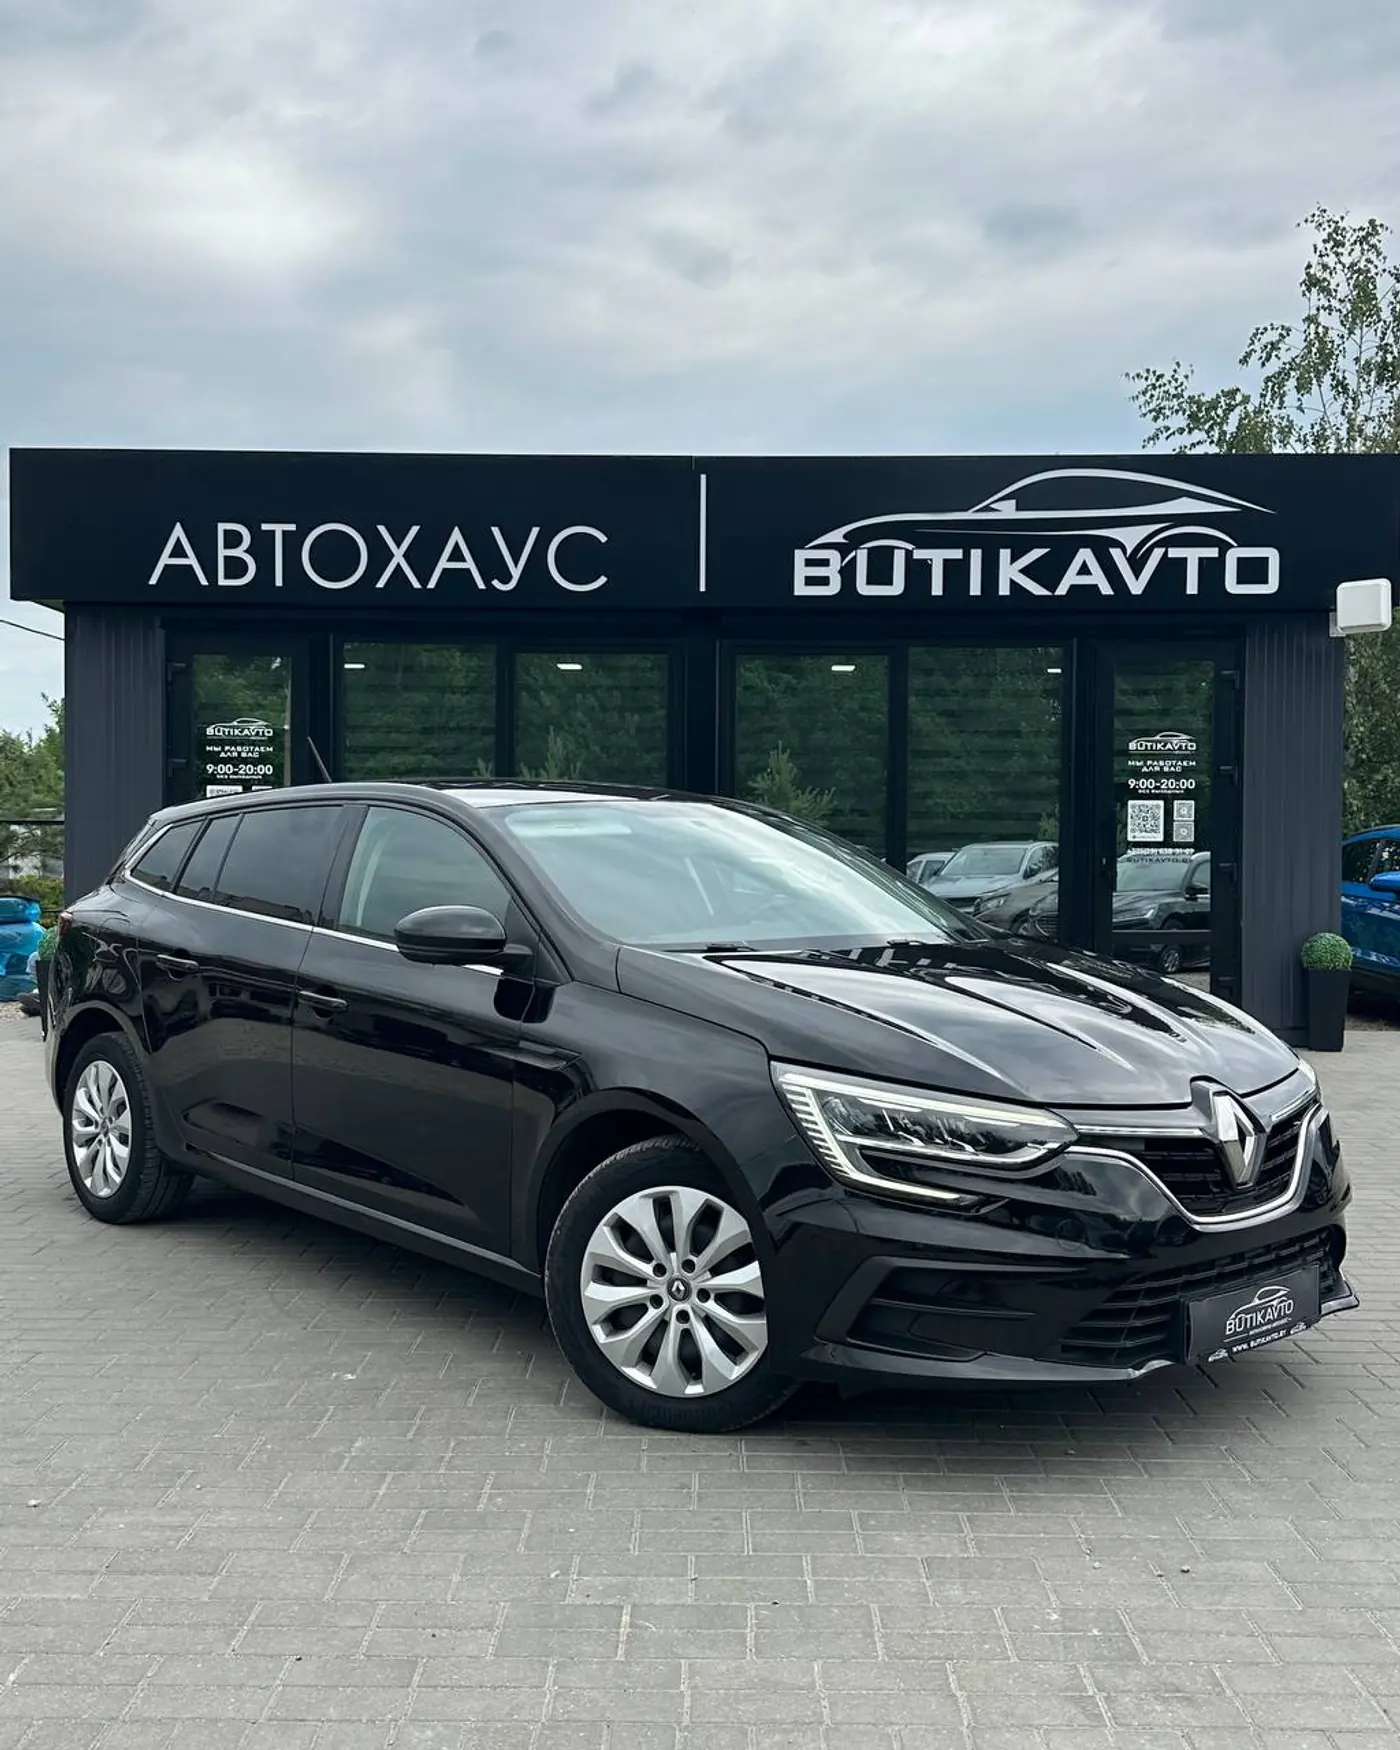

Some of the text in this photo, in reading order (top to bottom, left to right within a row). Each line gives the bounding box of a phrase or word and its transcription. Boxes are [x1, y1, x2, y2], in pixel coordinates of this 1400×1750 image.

[148, 521, 609, 593] АВТОХАУС
[793, 546, 1280, 597] BUTIKAVTO
[206, 727, 273, 737] BUTIKAVTO
[1128, 742, 1197, 751] BUTIKAVTO
[206, 764, 274, 775] 9:00-20:00
[1128, 779, 1196, 789] 9:00-20:00
[1225, 1299, 1294, 1335] BUTIKAVTO
